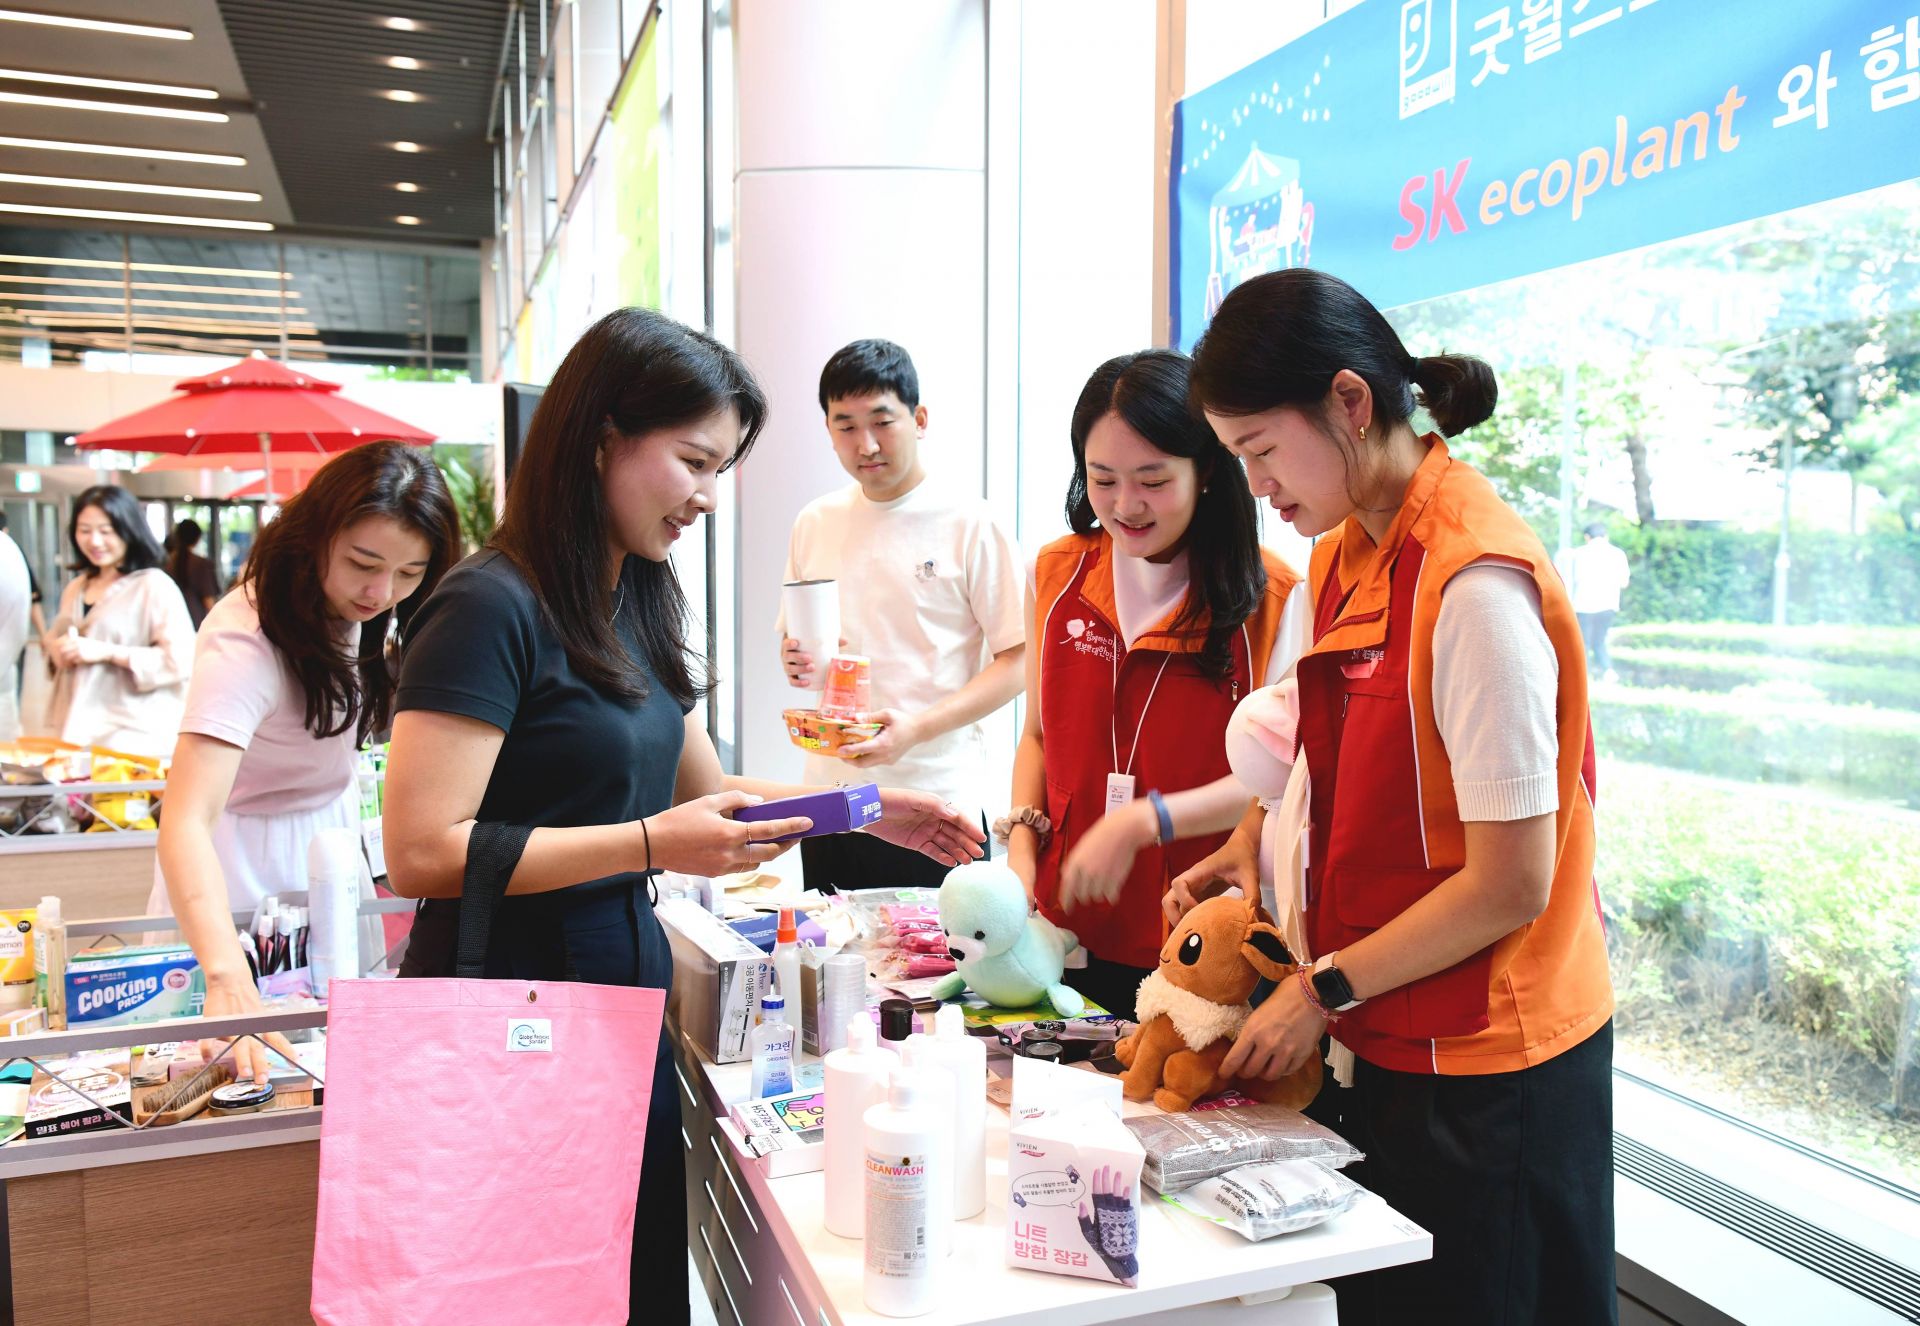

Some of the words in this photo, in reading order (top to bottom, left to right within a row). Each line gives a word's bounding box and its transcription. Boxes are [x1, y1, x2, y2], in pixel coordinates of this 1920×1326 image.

[1392, 157, 1474, 250] SK
[1479, 84, 1748, 226] ecoplant
[1773, 49, 1838, 130] 와
[1859, 15, 1920, 113] 함
[764, 1040, 791, 1052] 가그린
[1016, 1142, 1038, 1151] VIVIEN
[866, 1159, 924, 1176] CLEANWASH
[1014, 1219, 1048, 1244] 니트
[1014, 1240, 1049, 1261] 방한
[1053, 1247, 1088, 1268] 장갑
